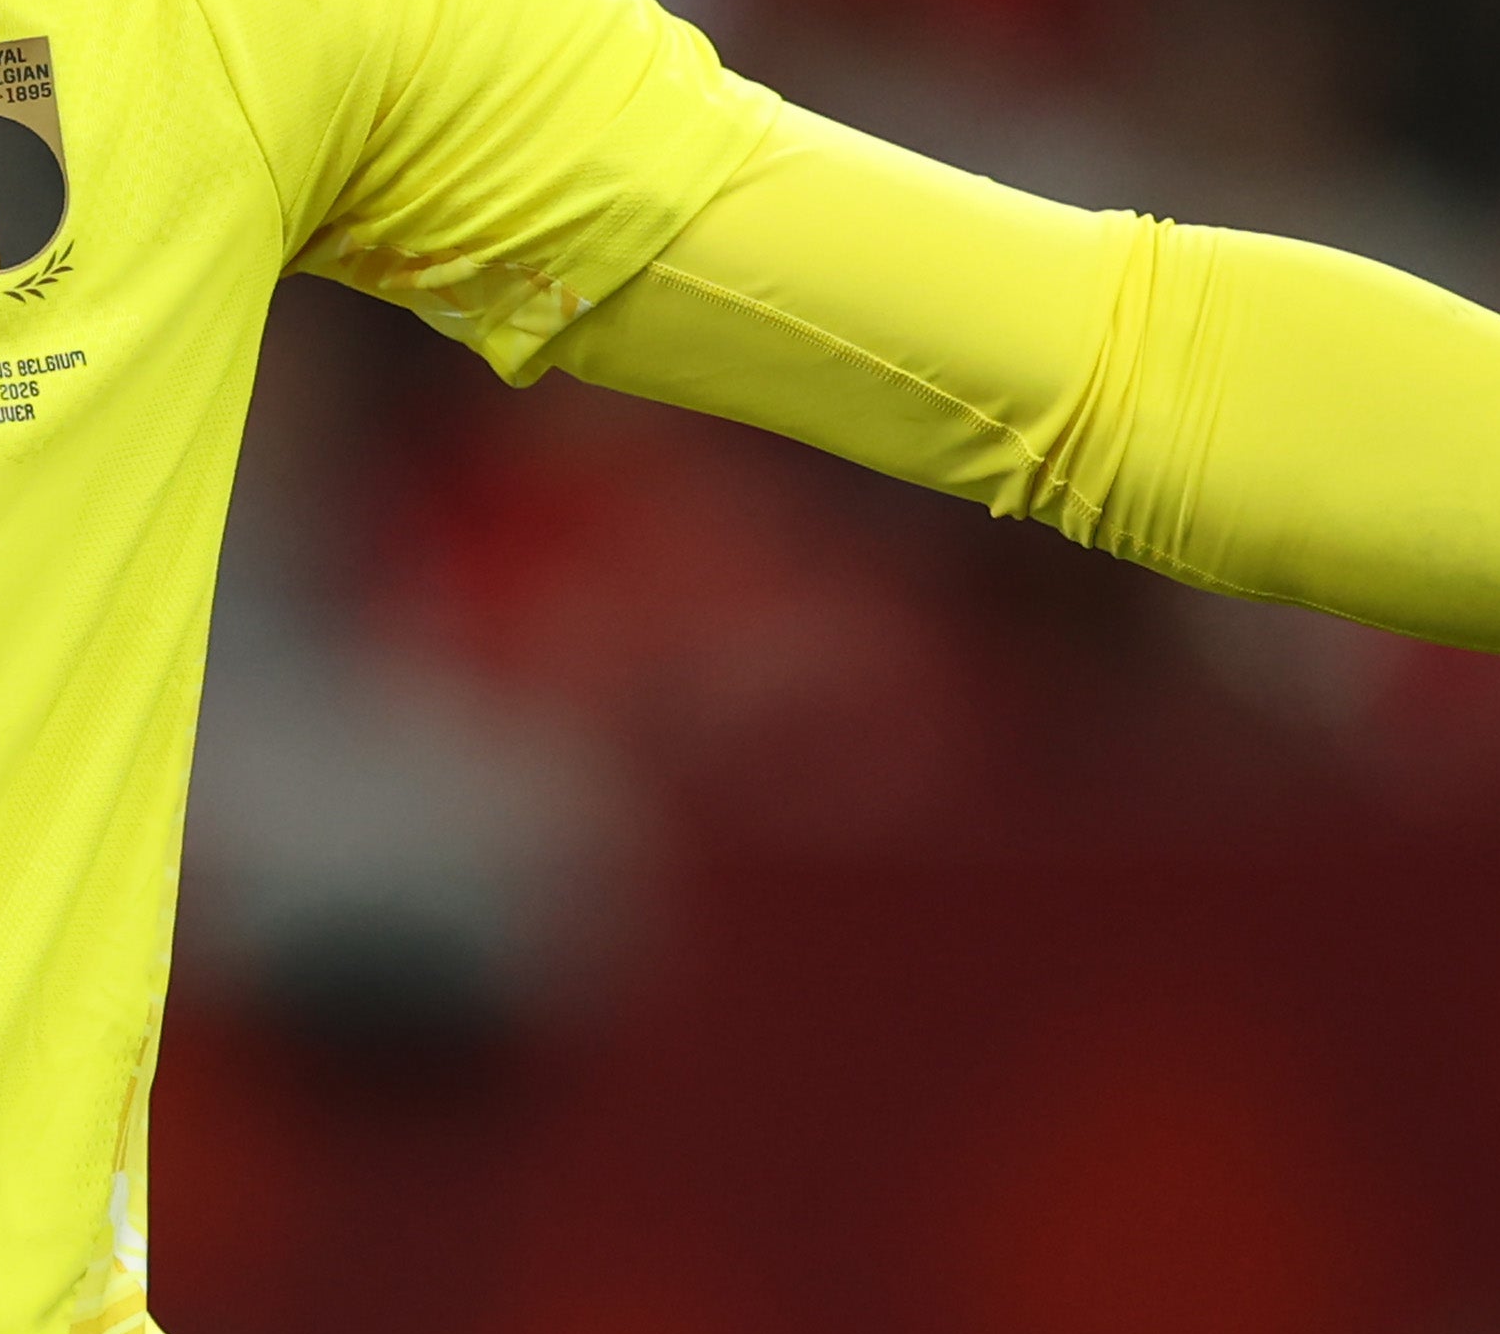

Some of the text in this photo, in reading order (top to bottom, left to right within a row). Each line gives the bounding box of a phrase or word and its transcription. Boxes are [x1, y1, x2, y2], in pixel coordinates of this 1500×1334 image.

[6, 82, 52, 104] 1895
[17, 350, 88, 378] BELGIUM
[0, 380, 40, 401] 2026
